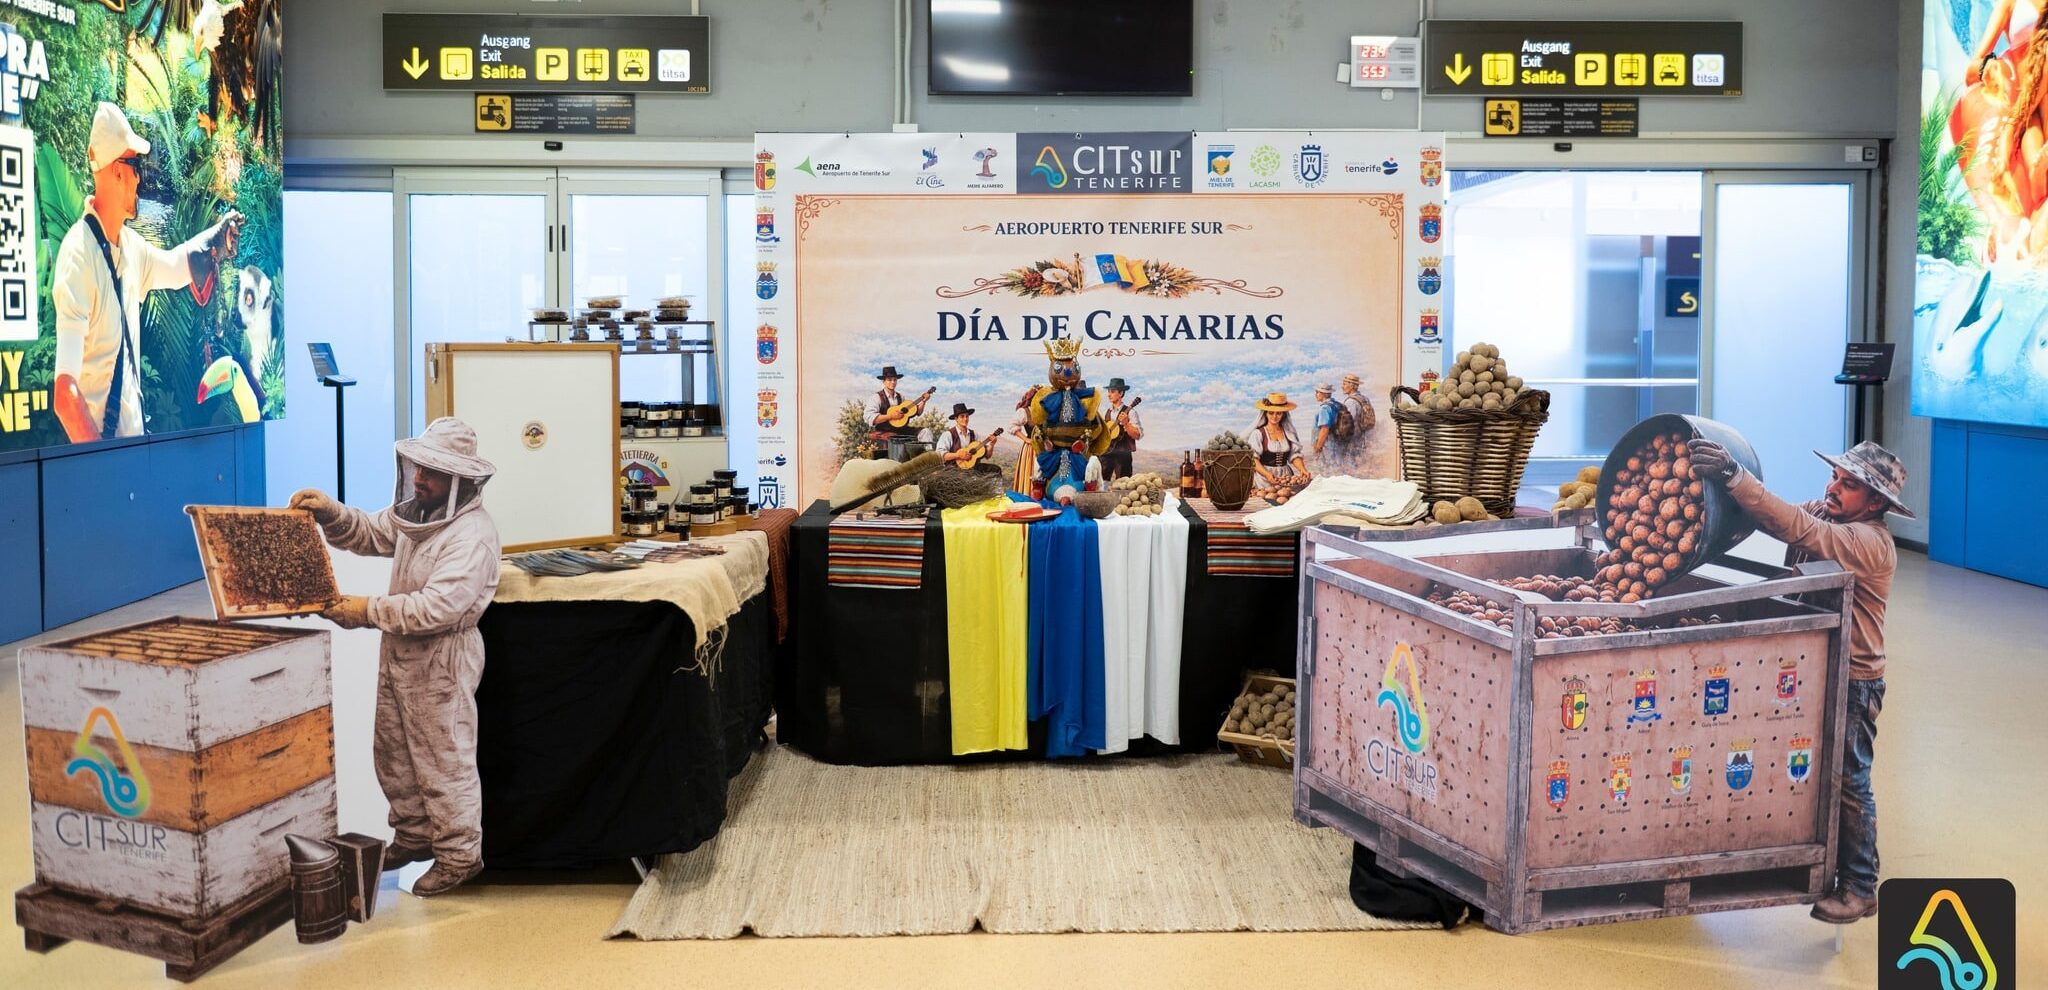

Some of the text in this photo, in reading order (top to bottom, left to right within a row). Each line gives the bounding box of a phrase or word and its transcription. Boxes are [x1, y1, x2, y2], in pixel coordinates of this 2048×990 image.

[56, 4, 76, 25] SUR
[481, 34, 530, 48] Ausgang
[1521, 40, 1570, 54] Ausgang
[481, 50, 502, 62] Exit
[1521, 55, 1542, 68] Exit
[481, 64, 527, 79] Salida
[545, 54, 561, 75] P
[1583, 60, 1599, 80] P
[662, 69, 685, 79] titsa
[1521, 70, 1566, 85] Salida
[1696, 74, 1719, 83] titsa
[816, 163, 841, 171] aena
[1072, 145, 1182, 175] CITsur
[1292, 153, 1304, 184] CABILDO
[1315, 153, 1329, 186] TENERIFE
[1345, 164, 1382, 173] tenerife
[1074, 177, 1182, 189] TENERIFE
[994, 221, 1224, 236] AEROPUERTO TENERIFE SUR
[936, 307, 1285, 341] DÍA DE CANARIAS
